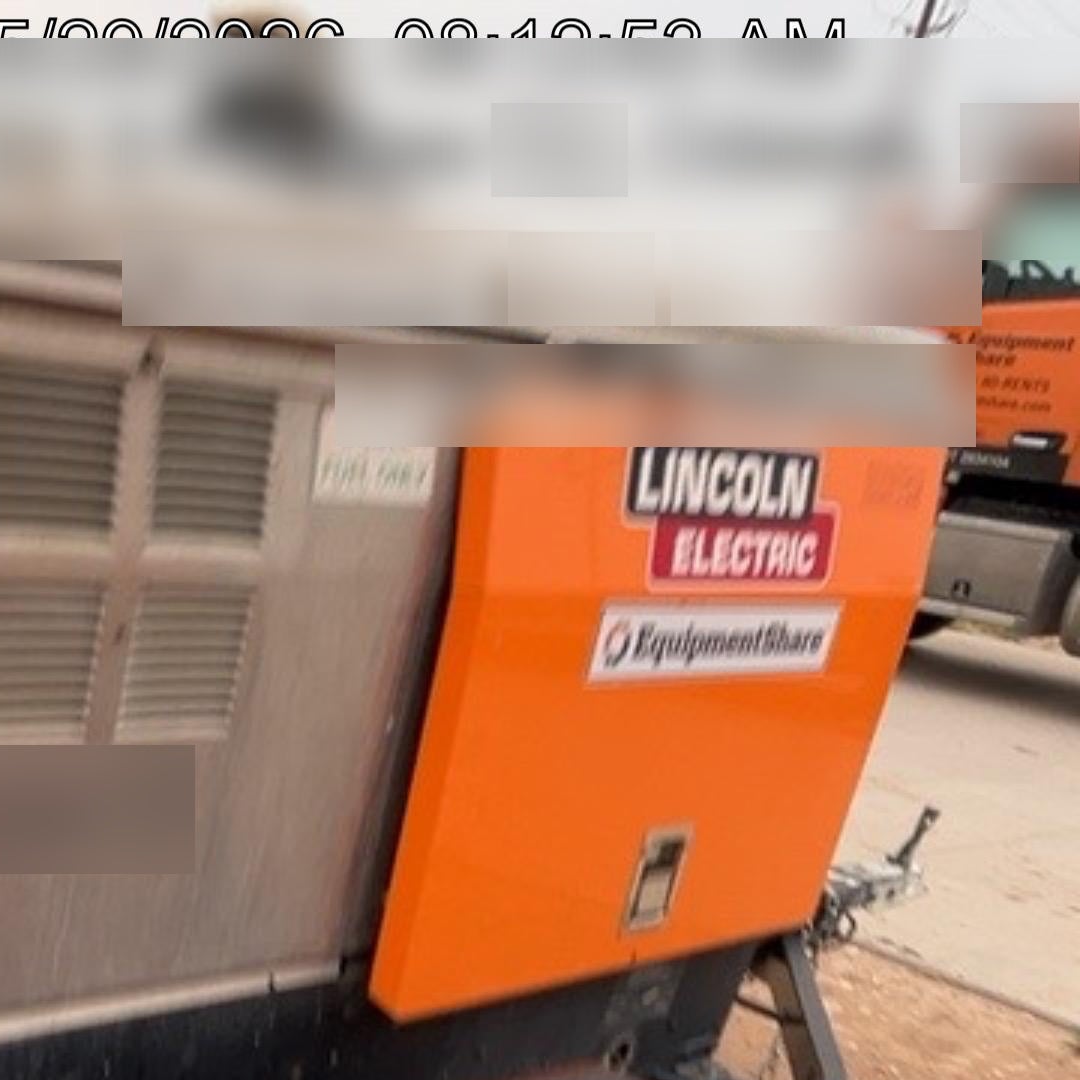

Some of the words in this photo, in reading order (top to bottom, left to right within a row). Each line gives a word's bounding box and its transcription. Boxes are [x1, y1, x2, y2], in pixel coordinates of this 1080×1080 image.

[634, 447, 814, 520] LINCOLN
[671, 526, 819, 577] ELECTRIC
[633, 622, 824, 667] EquipmentShare
